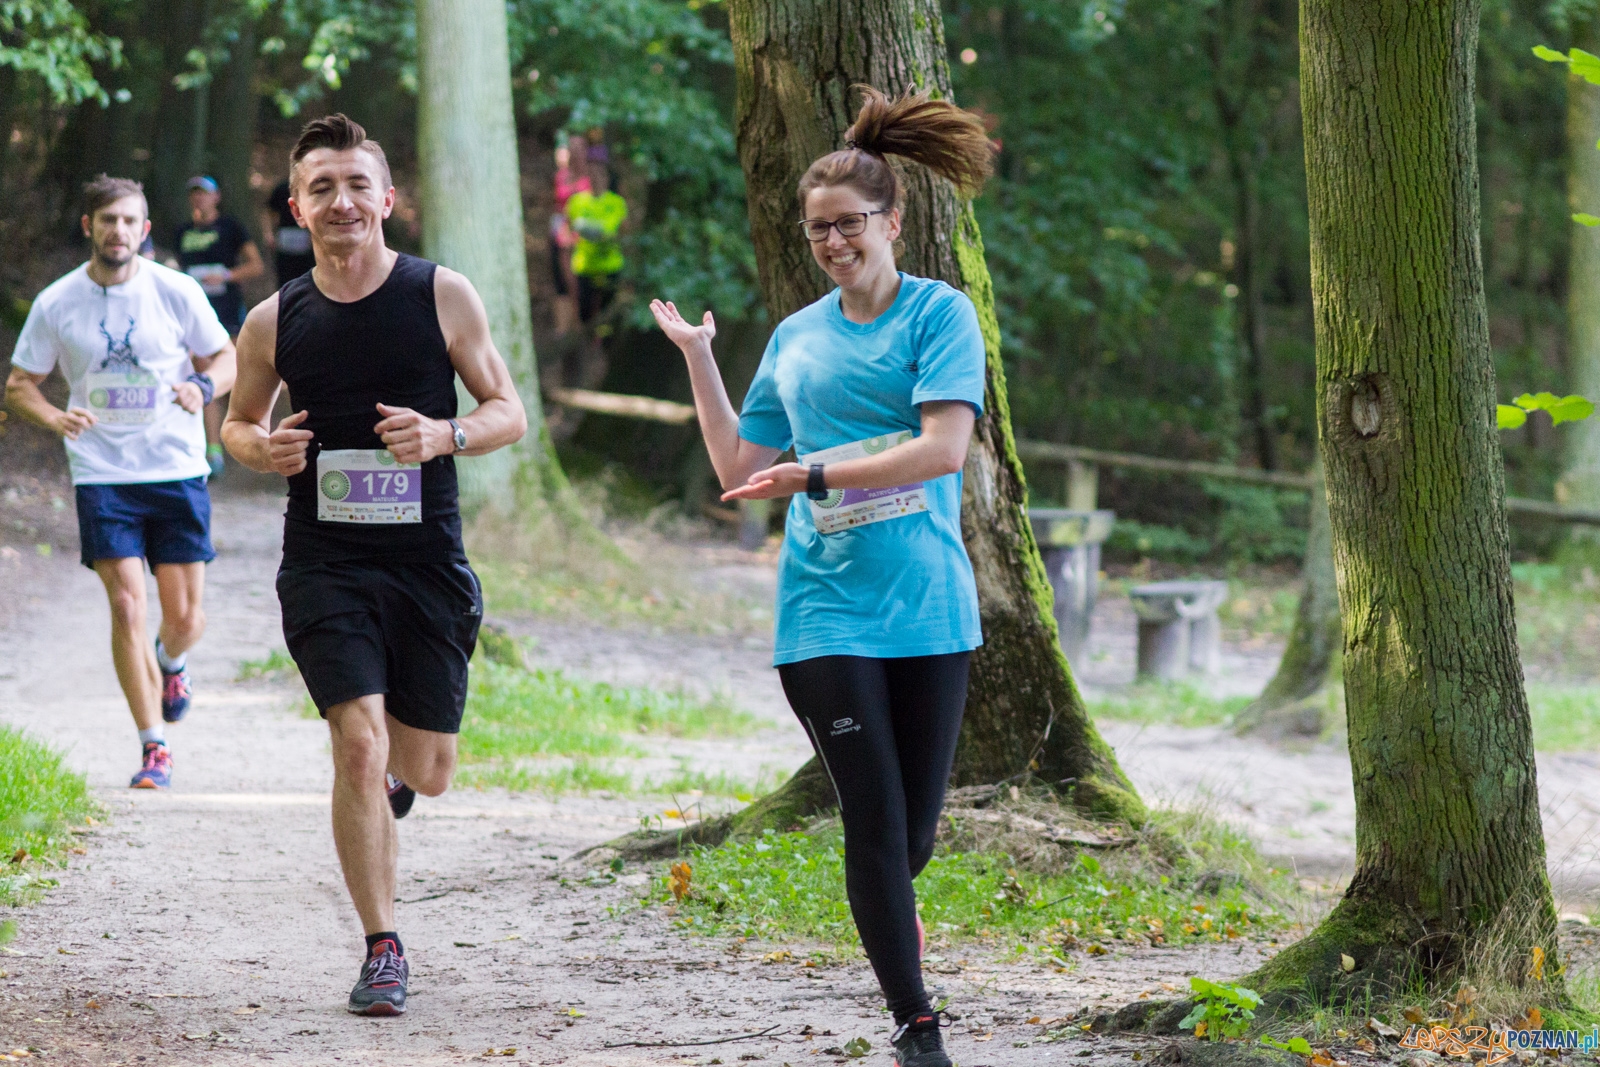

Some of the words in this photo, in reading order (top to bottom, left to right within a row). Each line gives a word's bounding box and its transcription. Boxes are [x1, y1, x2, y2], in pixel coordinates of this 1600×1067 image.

[116, 388, 149, 406] 208
[362, 472, 409, 495] 179
[868, 487, 900, 499] PATRYCJA
